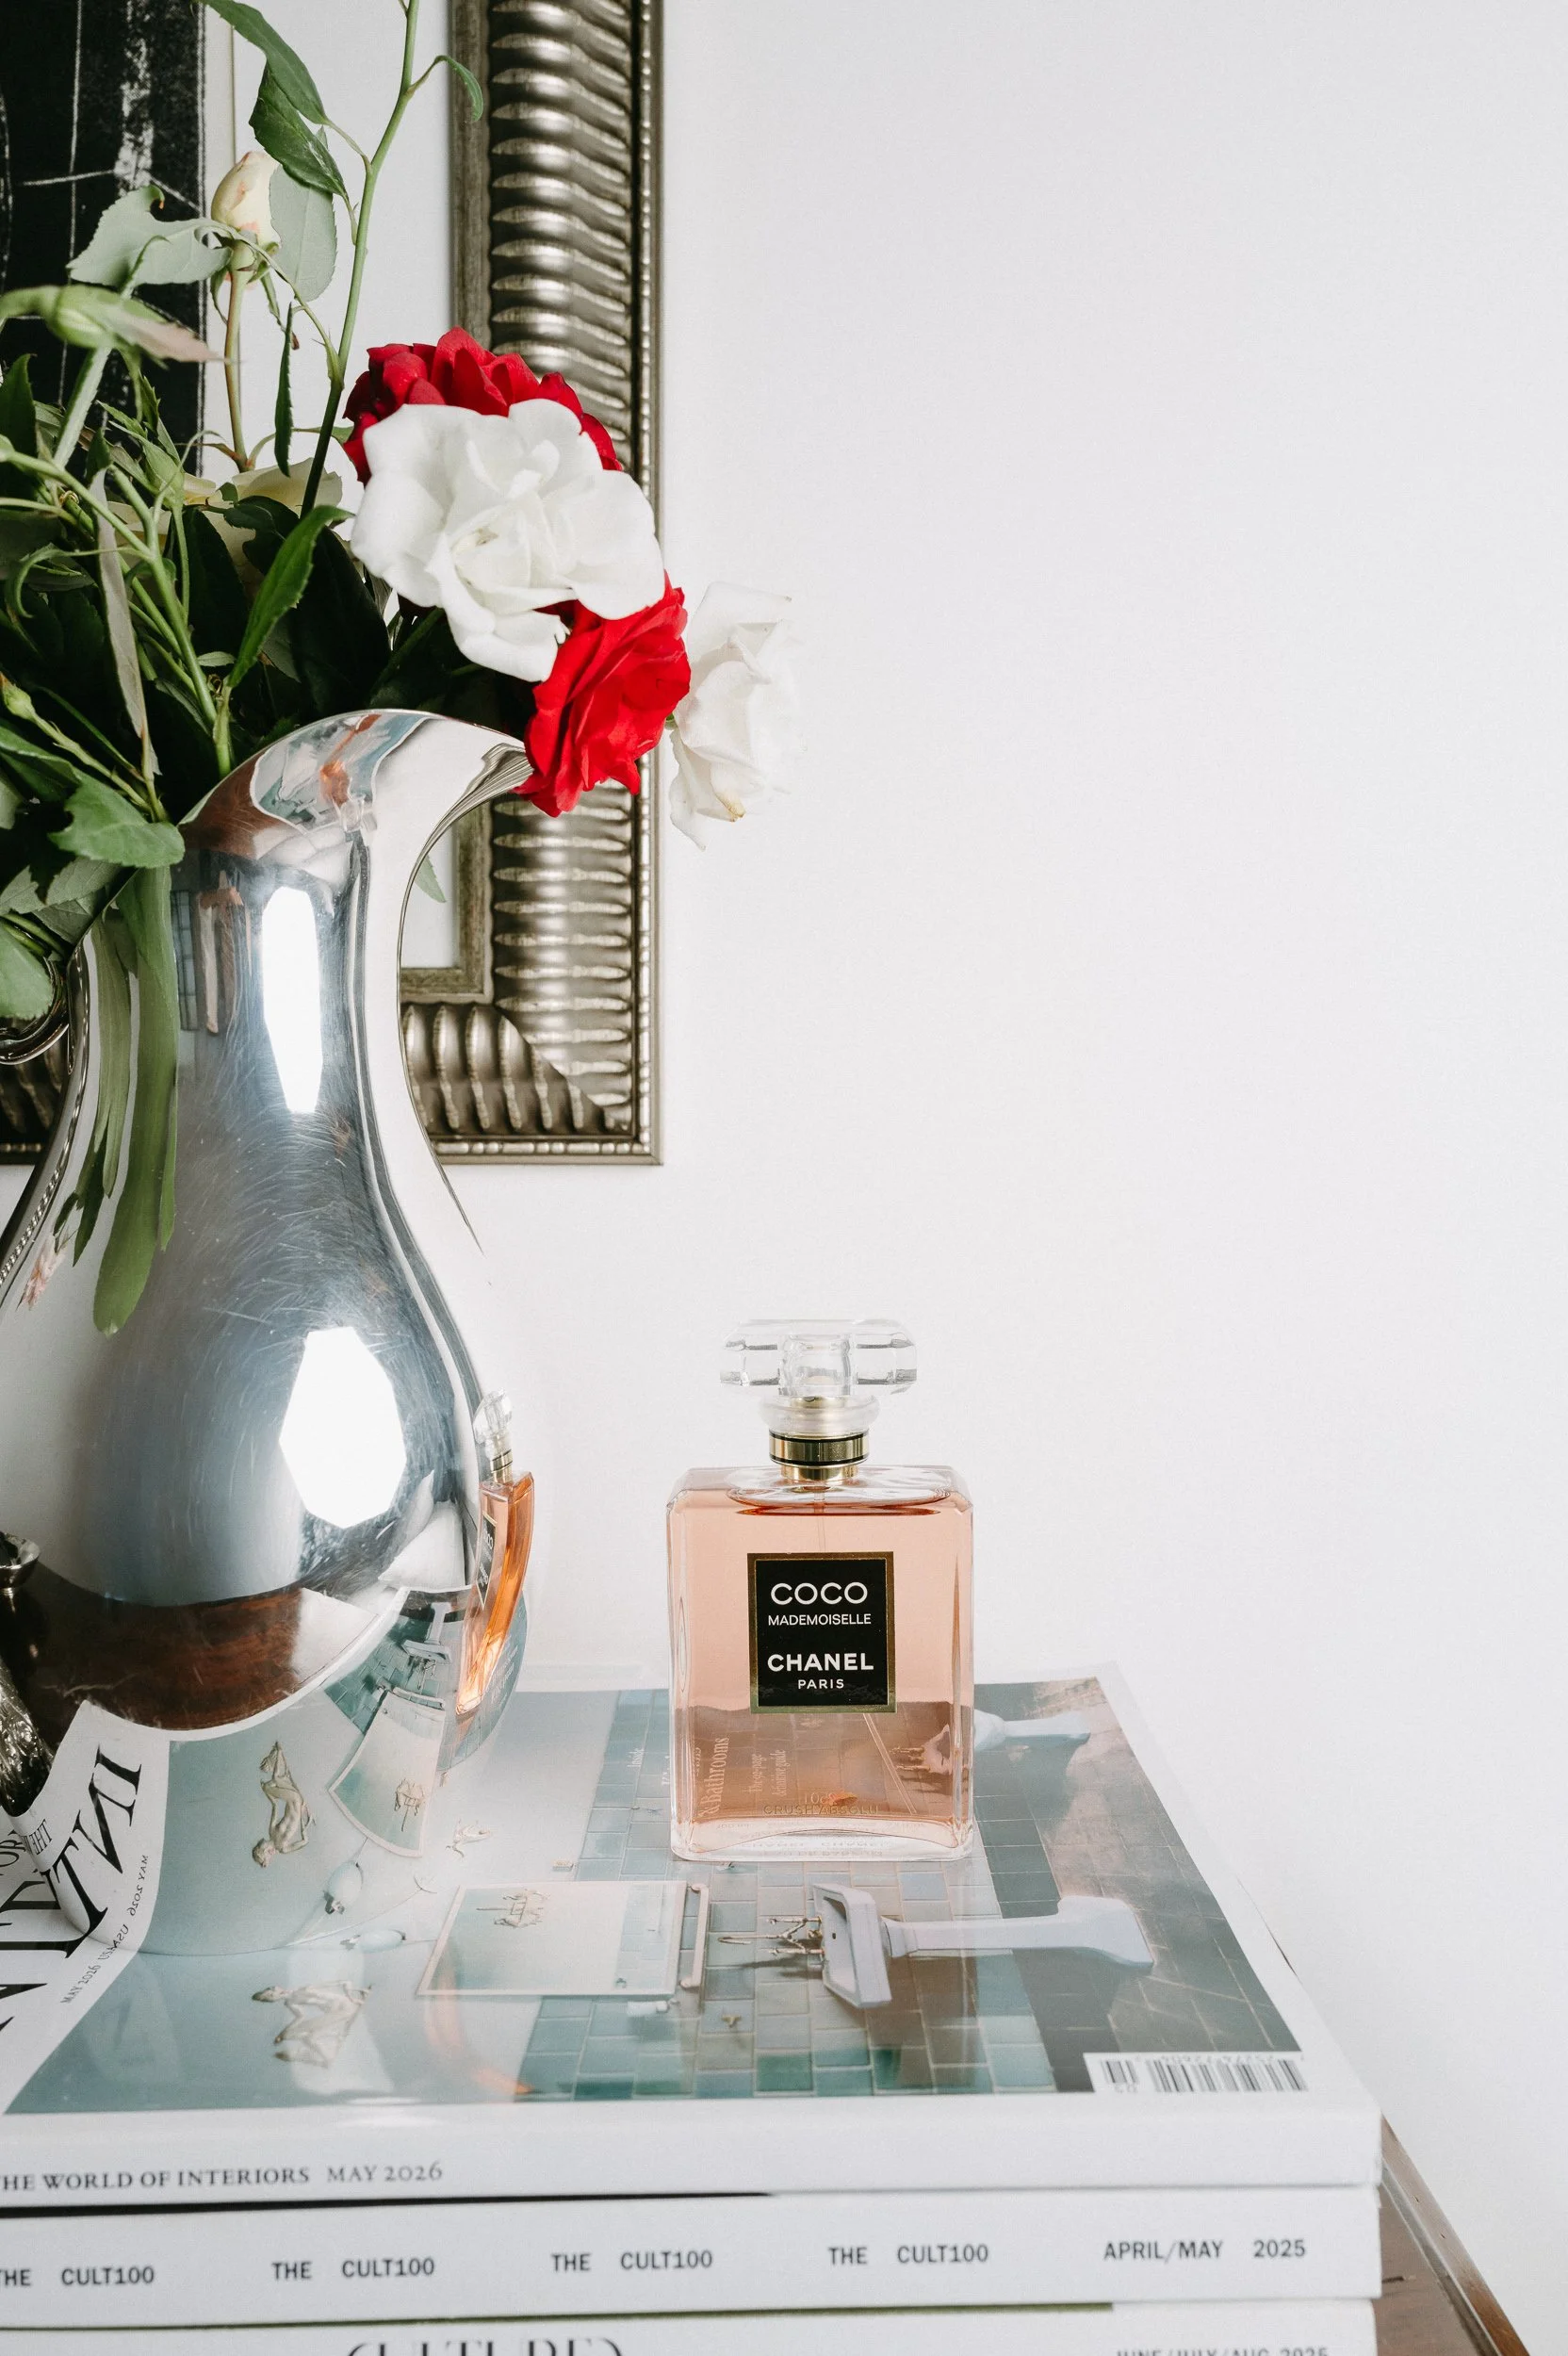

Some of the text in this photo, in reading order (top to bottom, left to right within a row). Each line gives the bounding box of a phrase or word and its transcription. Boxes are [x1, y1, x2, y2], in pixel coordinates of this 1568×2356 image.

[770, 1581, 868, 1606] COCO
[768, 1612, 872, 1627] MADEMOISELLE
[767, 1652, 874, 1673] CHANEL
[797, 1678, 844, 1690] PARIS
[701, 1737, 730, 1802] Bathrooms
[59, 1986, 83, 2004] MAY
[79, 1964, 102, 1985] 2026
[0, 2162, 443, 2191] HE WORLD OF INTERIORS MAY 2026
[60, 2266, 155, 2286] CULT100
[271, 2262, 312, 2281] THE
[341, 2258, 435, 2279] CULT100
[551, 2253, 591, 2272] THE
[620, 2250, 713, 2270] CULT100
[828, 2246, 868, 2266] THE
[896, 2243, 989, 2265] CULT100
[1103, 2240, 1223, 2263] APRIL/MAY
[1253, 2239, 1306, 2258] 2025
